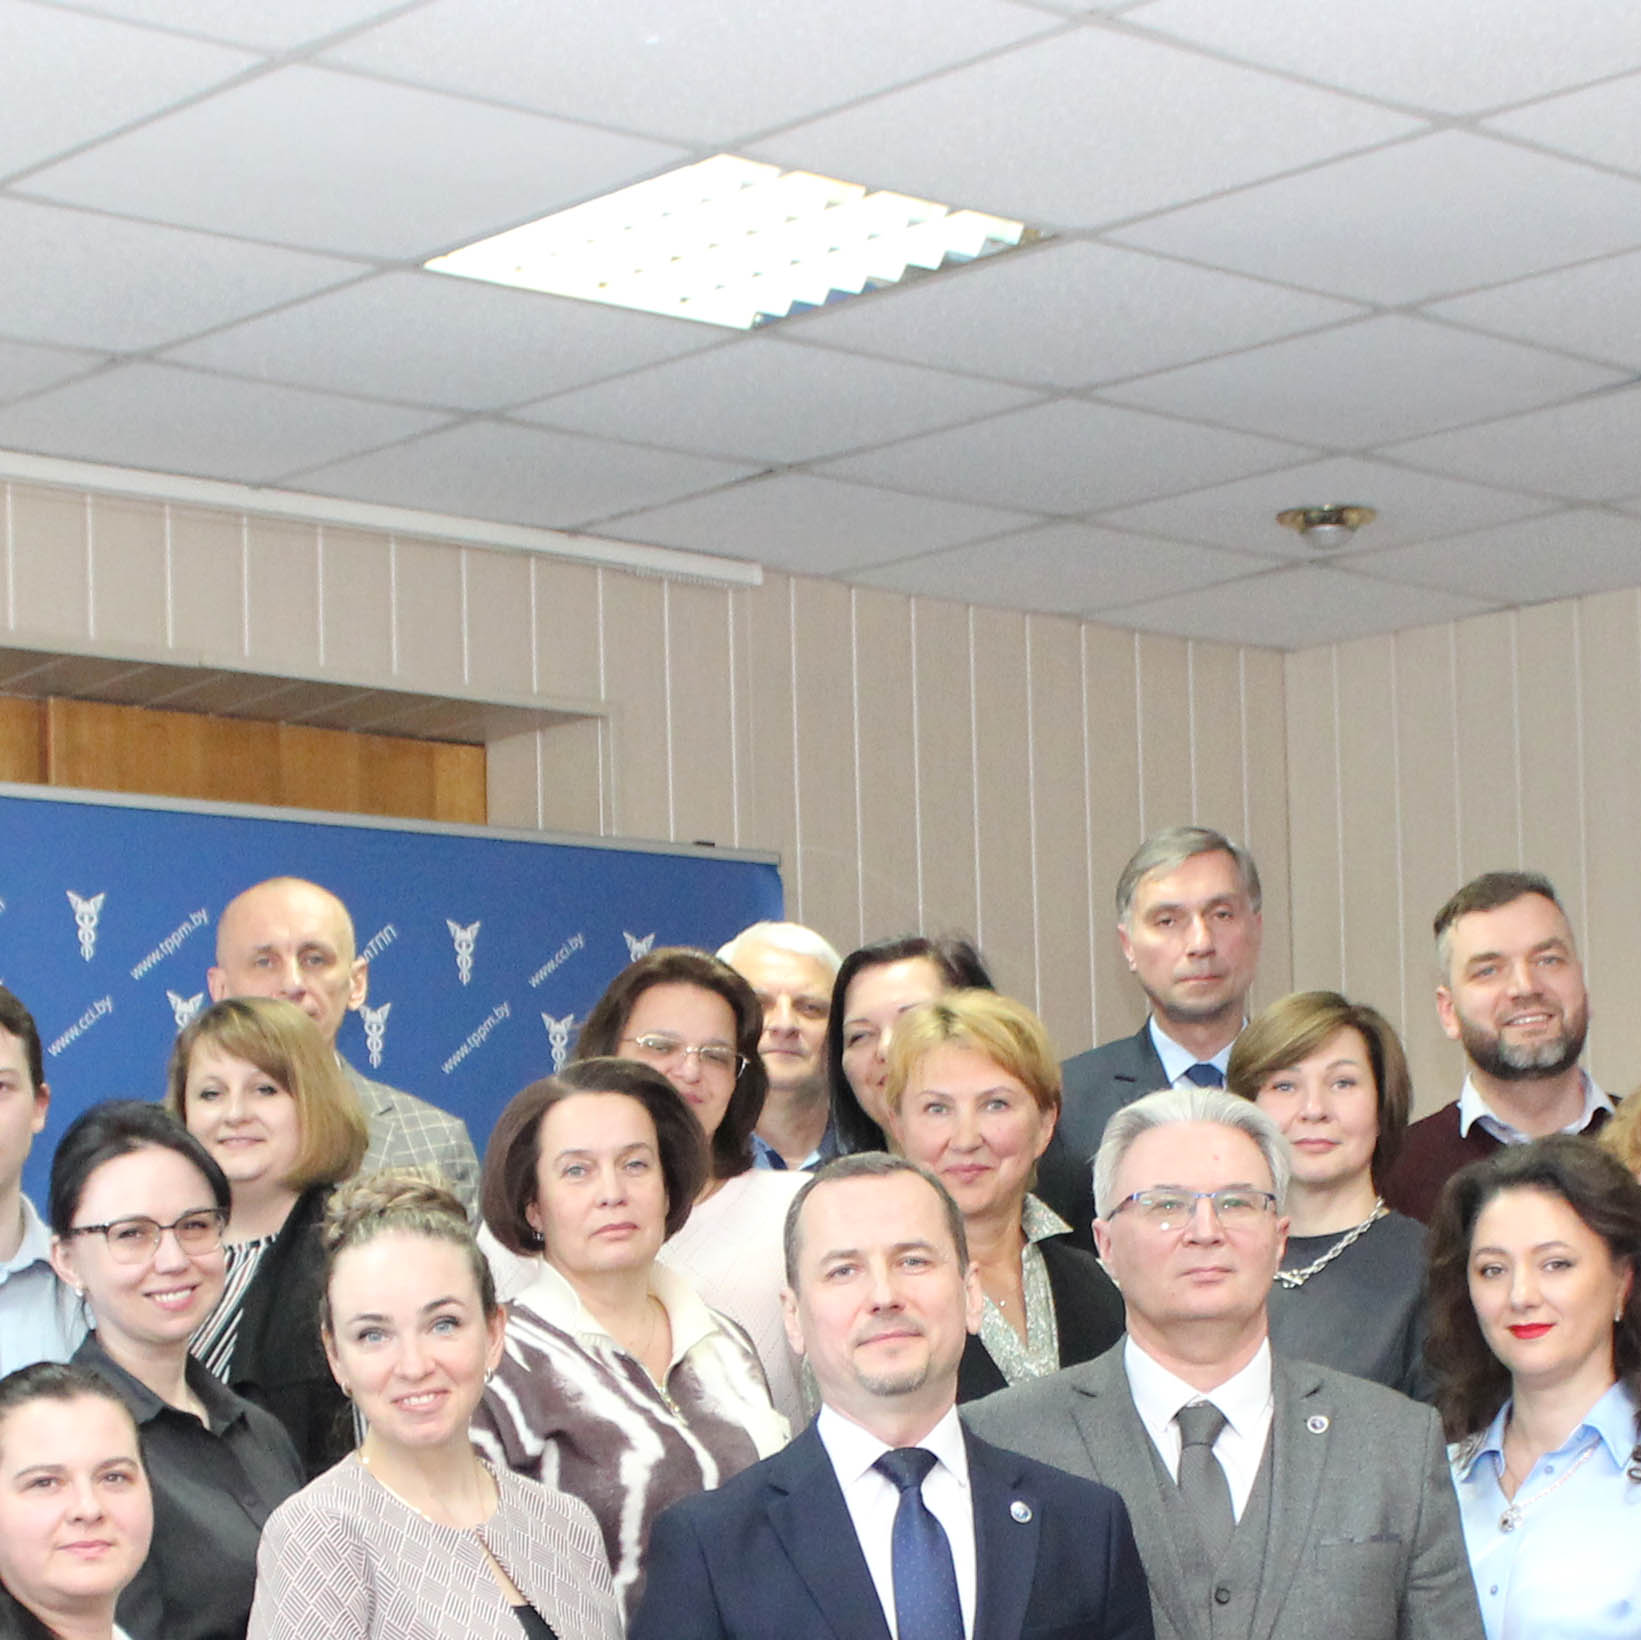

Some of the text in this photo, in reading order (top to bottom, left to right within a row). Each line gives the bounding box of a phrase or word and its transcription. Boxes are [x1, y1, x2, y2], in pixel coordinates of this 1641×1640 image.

[129, 907, 209, 981] www.tppm.by
[362, 925, 398, 963] лТПП
[528, 932, 585, 989] www.cci.by
[47, 994, 113, 1057] www.cci.by
[441, 1001, 511, 1075] www.tppm.by
